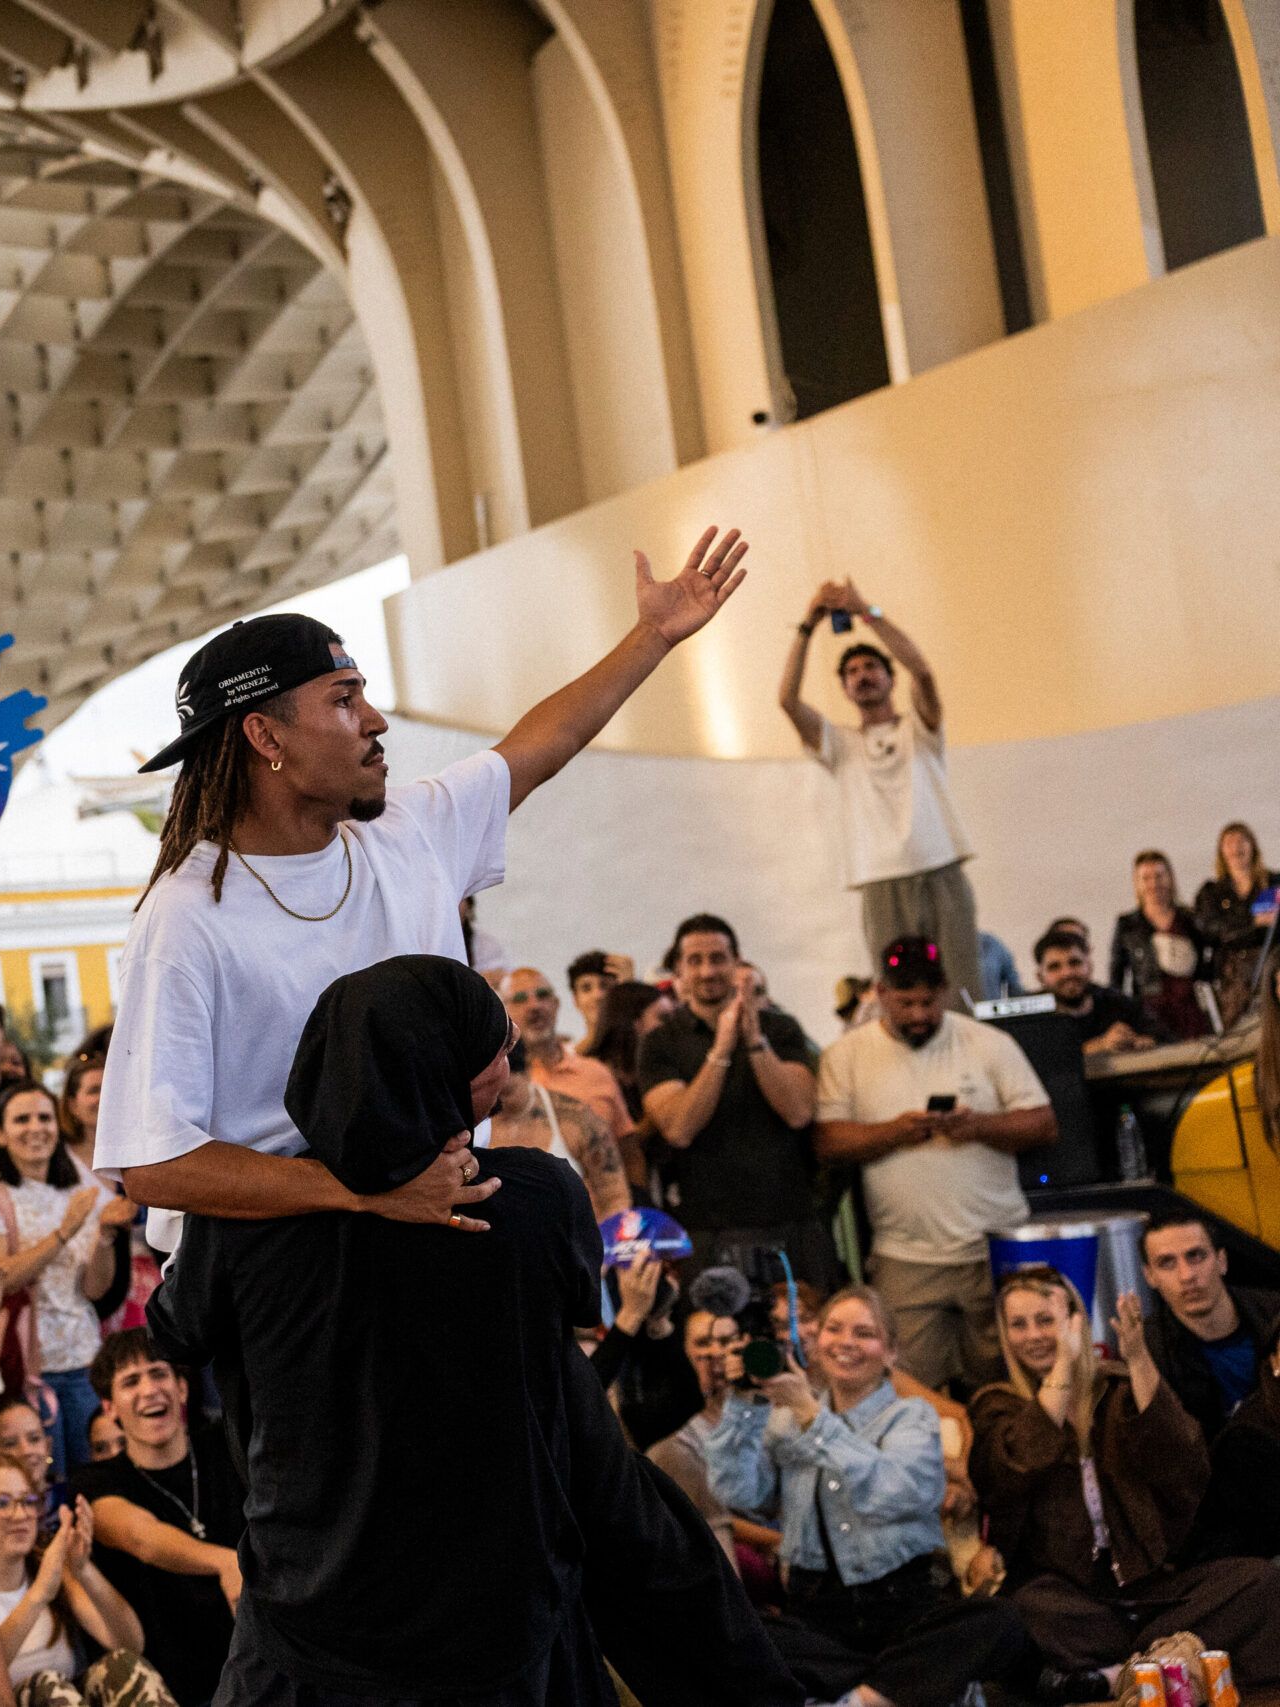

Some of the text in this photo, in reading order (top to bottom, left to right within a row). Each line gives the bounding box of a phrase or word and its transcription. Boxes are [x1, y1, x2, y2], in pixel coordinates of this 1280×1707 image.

[218, 664, 272, 689] ORNAMENTAL
[227, 676, 270, 697] by VIENEZE
[224, 682, 279, 707] all rights reserved
